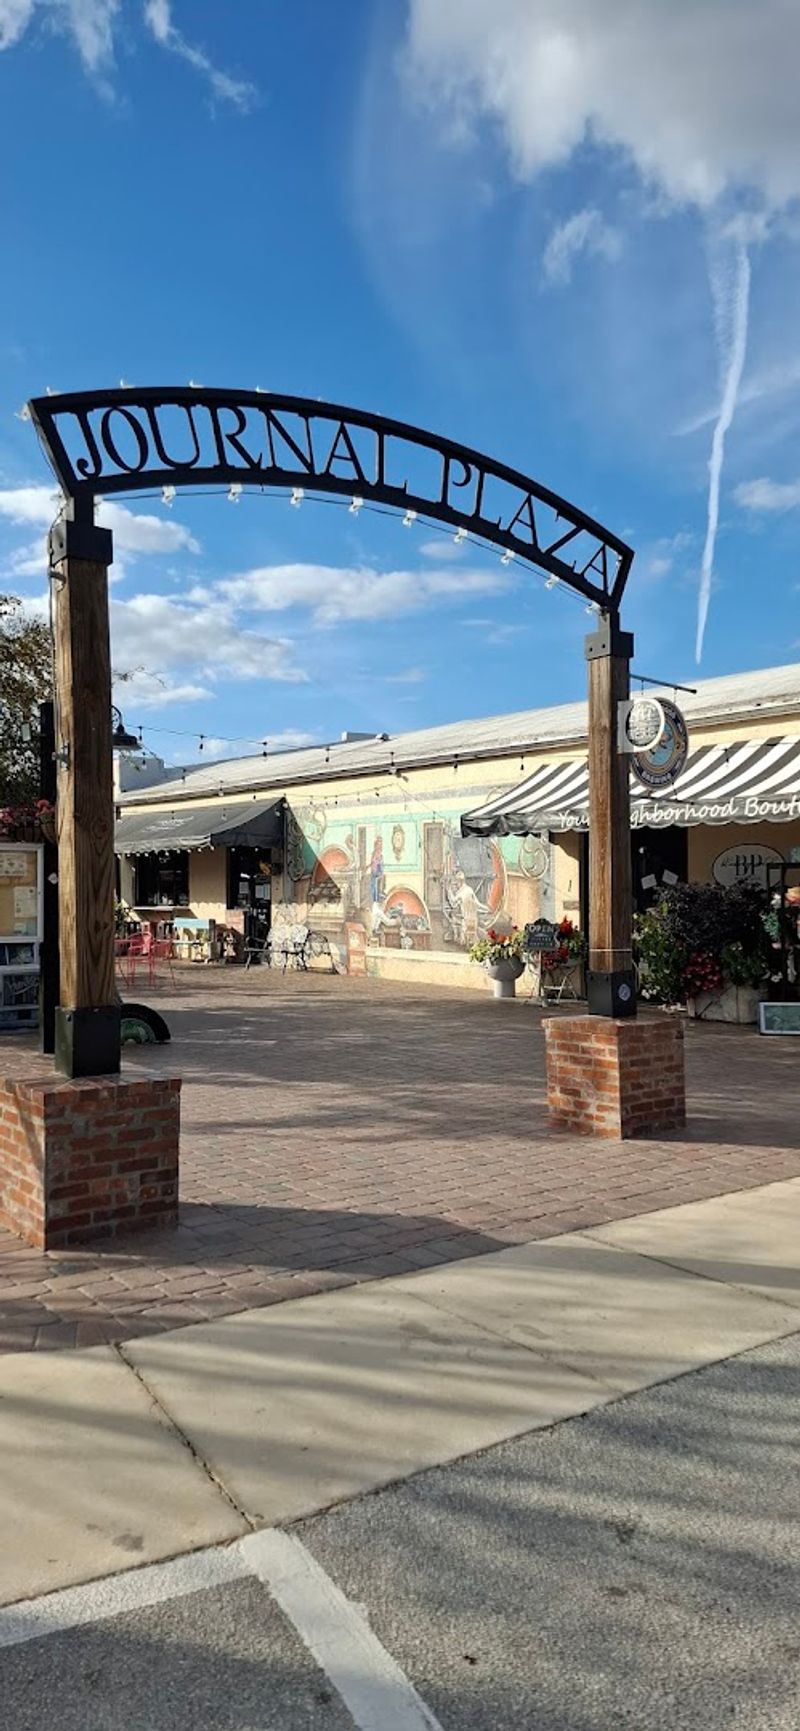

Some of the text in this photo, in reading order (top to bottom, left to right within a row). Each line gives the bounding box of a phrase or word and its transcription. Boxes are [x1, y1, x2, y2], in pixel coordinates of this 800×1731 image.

[68, 402, 611, 598] JOURNAL PLAZA
[630, 798, 738, 825] ghborhood
[734, 854, 763, 876] BP
